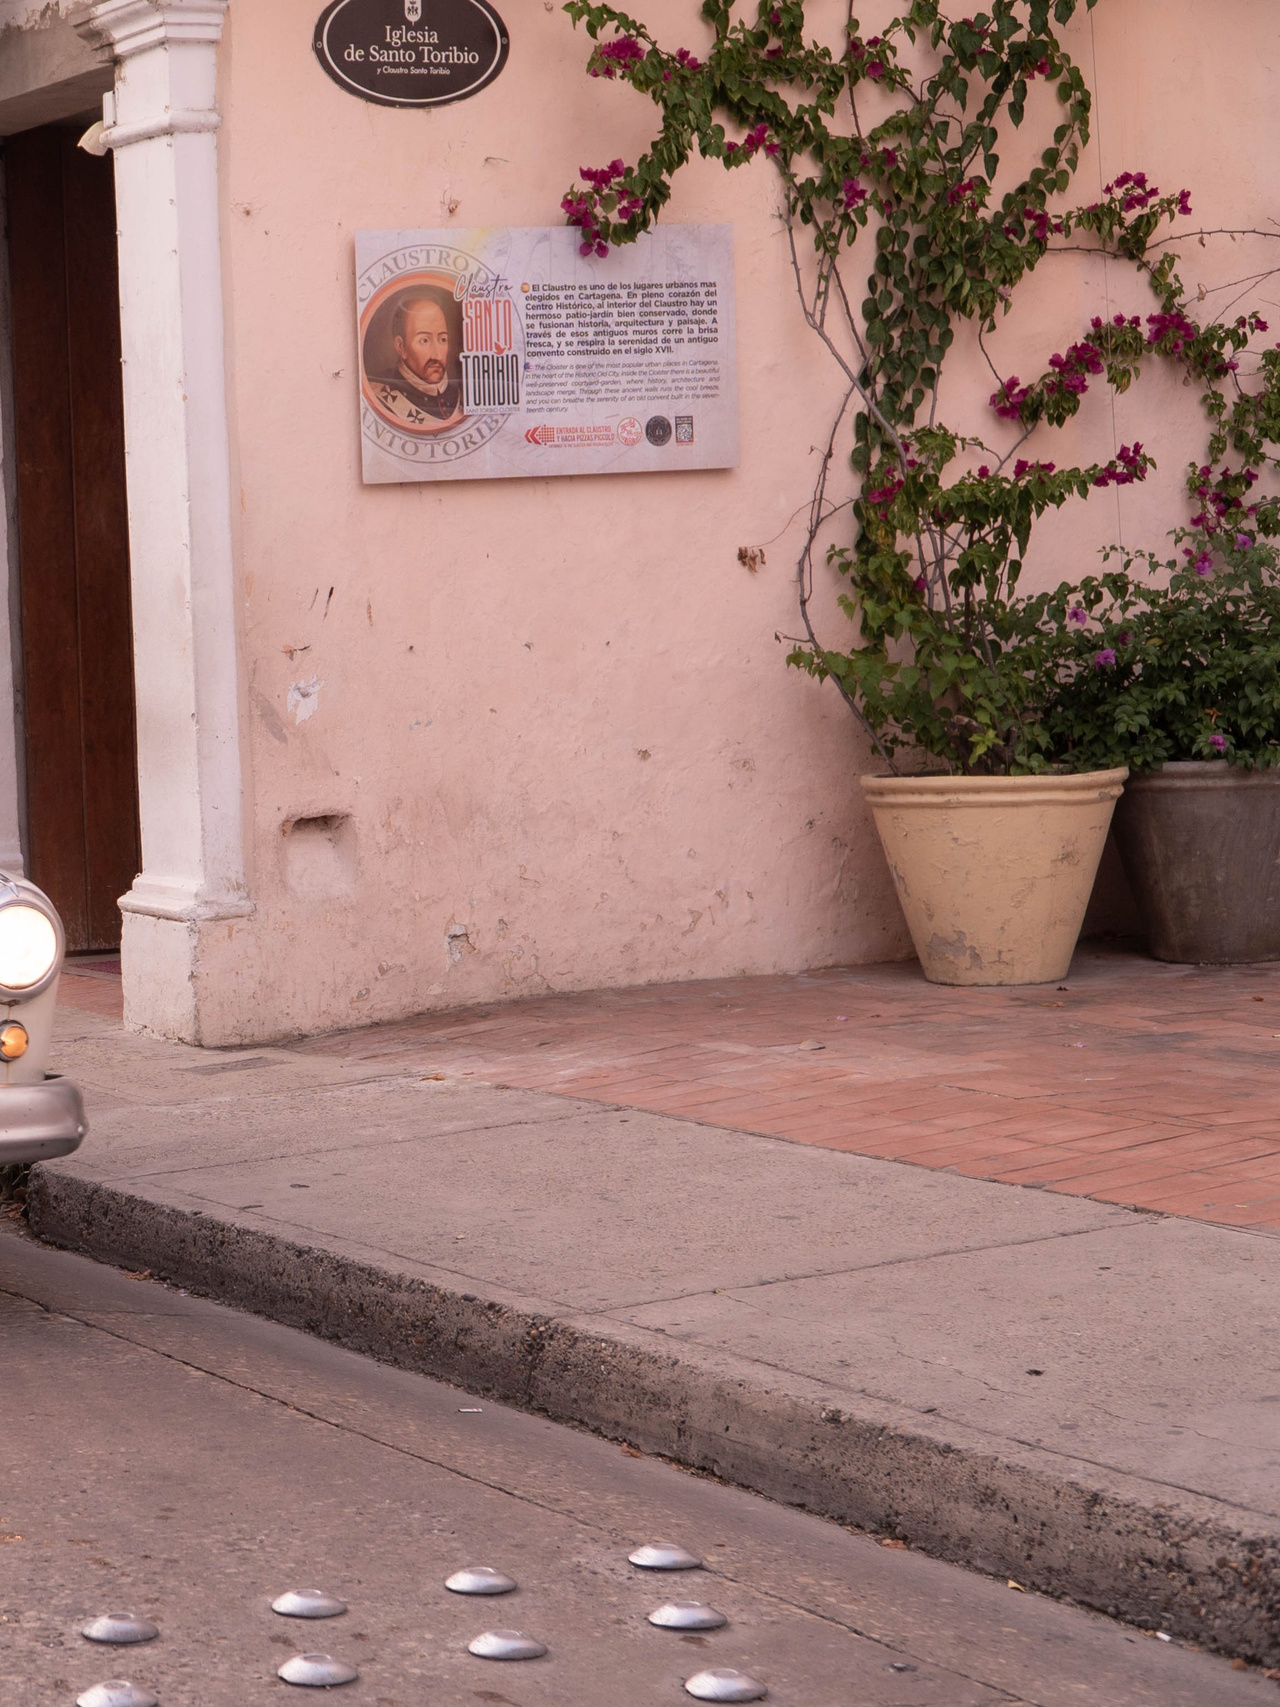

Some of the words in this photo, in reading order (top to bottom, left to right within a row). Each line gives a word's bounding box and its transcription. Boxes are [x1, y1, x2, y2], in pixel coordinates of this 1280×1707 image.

[385, 25, 439, 47] Iglesia
[344, 44, 365, 61] de
[369, 45, 416, 62] Santo
[419, 46, 479, 64] Toribio
[376, 67, 381, 75] y
[382, 65, 409, 74] Claustro
[410, 66, 428, 75] Santo
[429, 67, 451, 75] Toribio
[358, 249, 469, 302] CLAUSTRO
[454, 273, 513, 304] Claustro
[541, 283, 576, 291] Claustro
[607, 282, 617, 290] de
[619, 282, 631, 290] los
[633, 282, 663, 291] lugares
[665, 281, 697, 289] urbanos
[524, 293, 559, 302] elegidos
[578, 291, 622, 301] Cartagena.
[627, 291, 637, 299] En
[641, 291, 664, 300] pleno
[668, 290, 700, 298] corazón
[525, 302, 553, 310] Centro
[555, 301, 594, 311] Histórico,
[596, 301, 604, 309] al
[606, 300, 636, 308] interior
[639, 300, 651, 308] del
[654, 299, 687, 307] Claustro
[690, 299, 704, 308] hay
[525, 311, 561, 319] hermoso
[639, 309, 687, 318] conservado,
[691, 308, 716, 316] donde
[465, 299, 512, 352] SANTO
[538, 320, 574, 329] fusionan
[577, 320, 611, 329] historia,
[614, 318, 664, 328] arquitectura
[668, 319, 673, 327] y
[677, 317, 707, 327] paisaje.
[711, 317, 717, 325] A
[526, 330, 552, 338] través
[555, 330, 566, 338] de
[592, 328, 628, 338] antiguos
[686, 327, 694, 335] la
[697, 326, 718, 334] brisa
[526, 339, 553, 349] fresca,
[577, 338, 605, 348] respira
[607, 338, 615, 346] la
[618, 337, 658, 345] serenidad
[687, 336, 718, 345] antiguo
[526, 349, 564, 357] convento
[566, 348, 611, 356] construido
[623, 347, 632, 355] el
[632, 347, 653, 356] siglo
[654, 346, 674, 354] XVII.
[462, 354, 520, 407] TORIBIO
[556, 427, 578, 435] ENTRADA
[586, 425, 611, 434] CLAUSTRO
